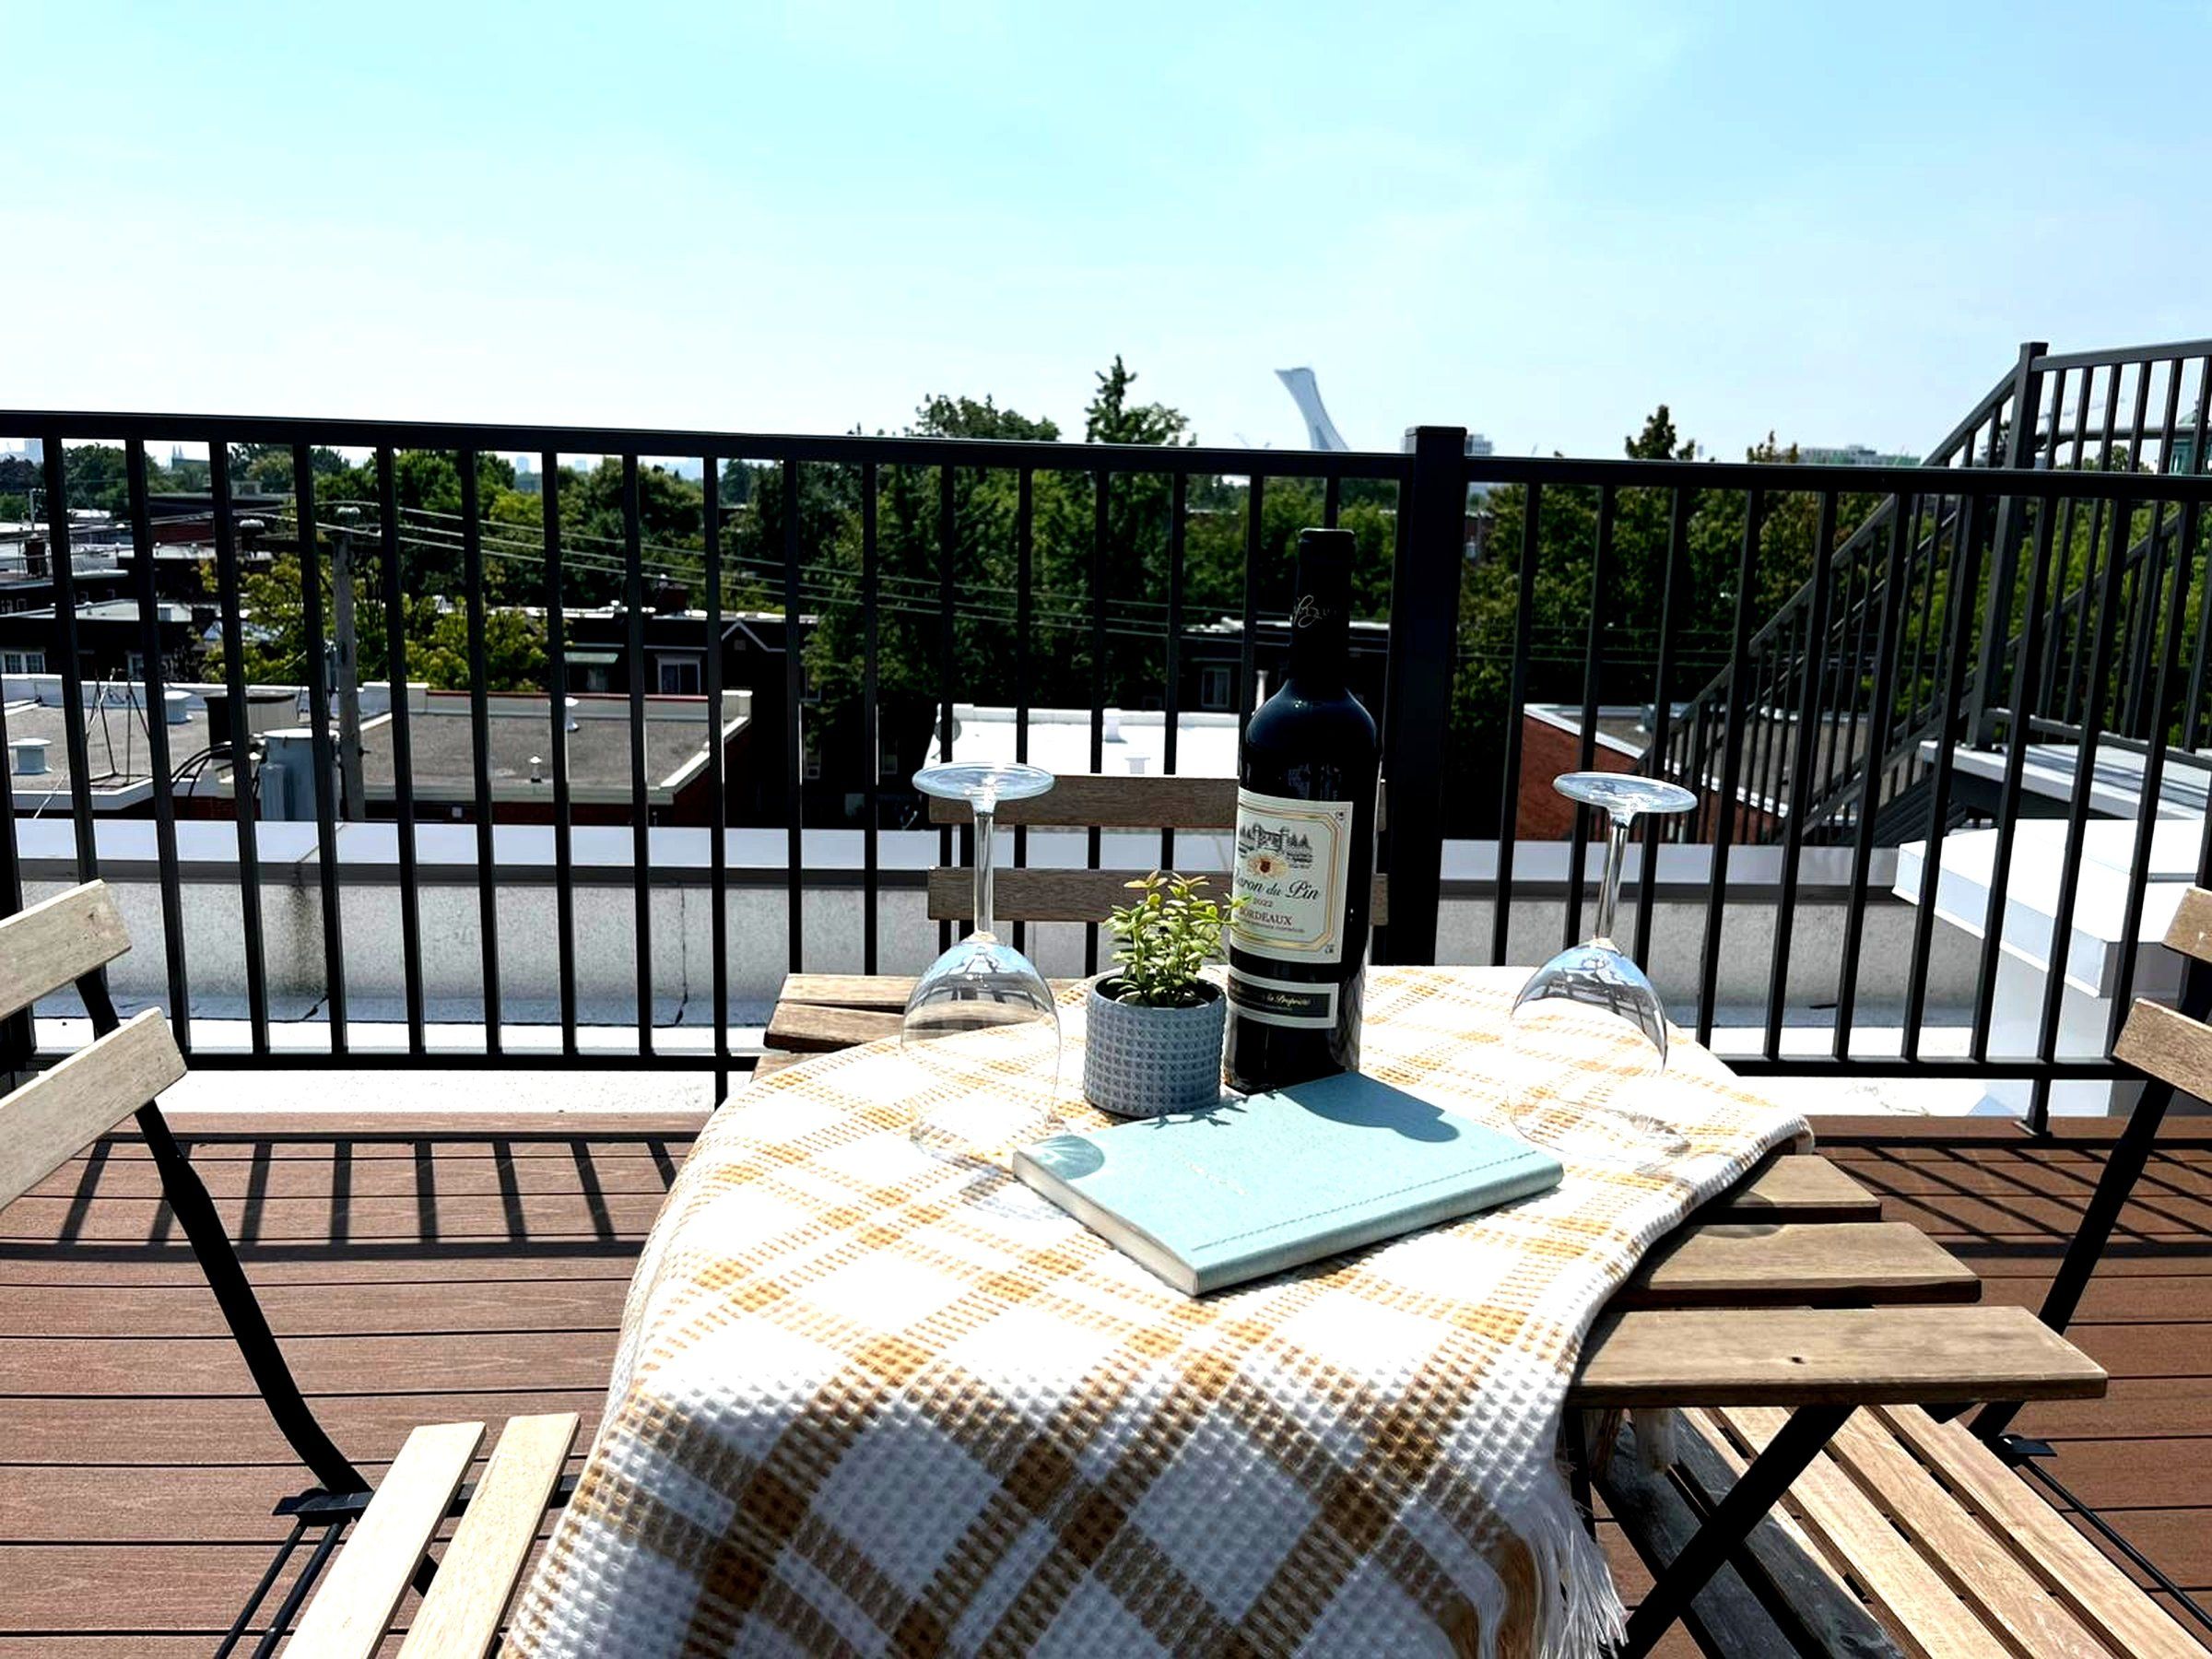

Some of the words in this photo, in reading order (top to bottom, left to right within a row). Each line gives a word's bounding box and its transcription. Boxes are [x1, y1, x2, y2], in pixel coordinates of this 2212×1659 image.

[1236, 872, 1263, 892] aron
[1265, 882, 1280, 897] du
[1286, 879, 1319, 900] Pin
